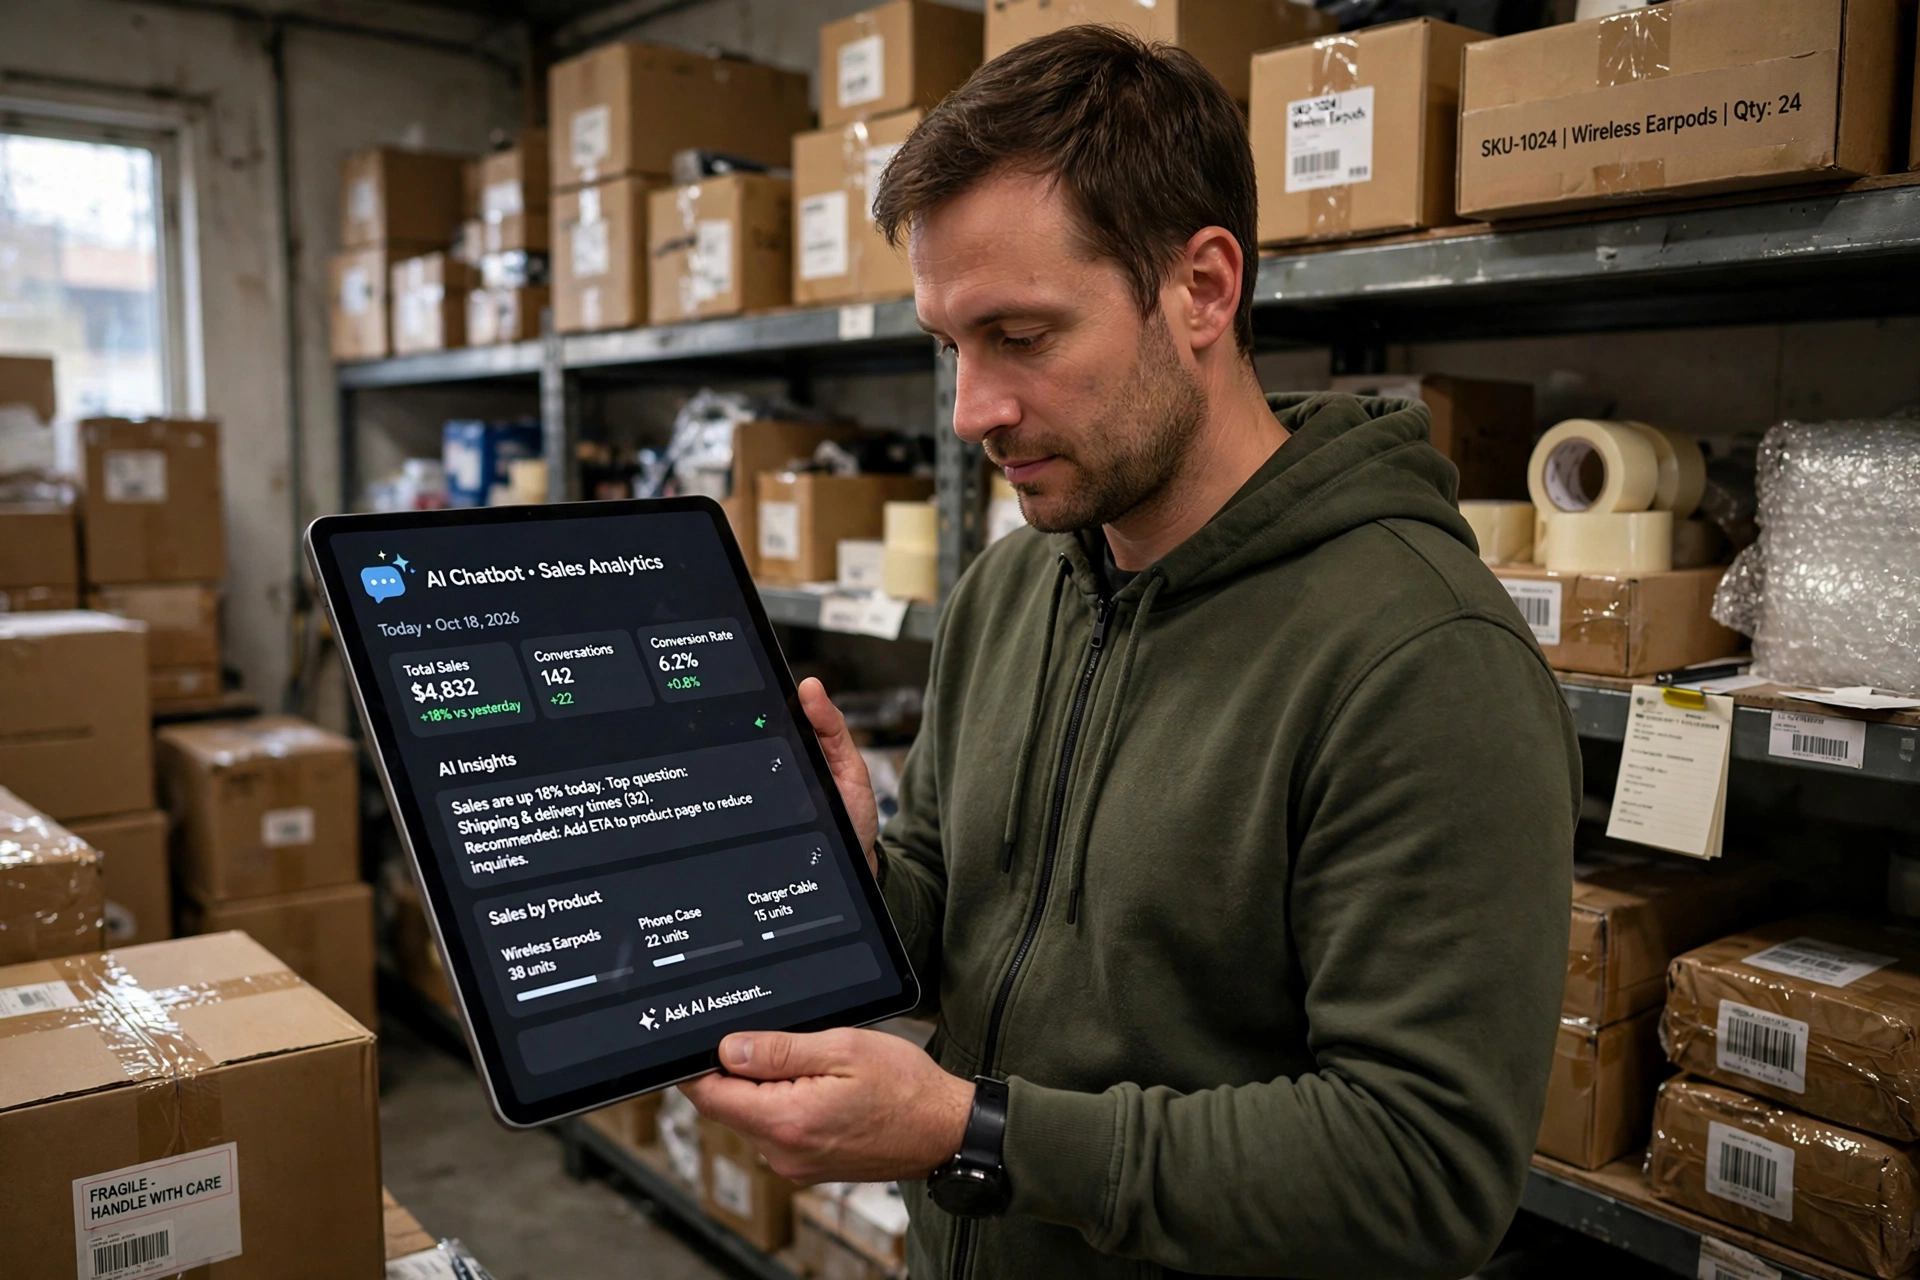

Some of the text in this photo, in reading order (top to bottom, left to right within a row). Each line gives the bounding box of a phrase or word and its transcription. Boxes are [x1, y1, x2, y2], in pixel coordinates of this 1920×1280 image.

[1481, 130, 1558, 158] SKU-1024
[1571, 120, 1641, 144] Wireless
[1645, 107, 1718, 136] Earpods
[1733, 98, 1772, 125] Qty:
[1778, 92, 1802, 114] 24
[427, 570, 447, 588] AI
[449, 565, 526, 586] Chatbot
[537, 558, 586, 579] Sales
[589, 554, 664, 575] Analytics
[377, 622, 422, 637] Today
[435, 617, 462, 632] Oct
[463, 615, 484, 630] 18,
[487, 611, 520, 627] 2026
[650, 630, 734, 649] Conversion Rate
[533, 643, 614, 663] Conversations
[658, 652, 699, 672] 6.2%
[403, 660, 470, 677] Total Sales
[541, 667, 575, 686] 142
[410, 677, 479, 704] $4,832
[666, 675, 701, 690] +0.8%
[420, 699, 522, 723] +18% vs yesterday
[550, 692, 575, 705] +22
[438, 752, 517, 777] AI Insights
[452, 767, 688, 816] Sales are up 18% today. Top question:
[458, 790, 654, 836] Shipping & delivery times (32).
[464, 793, 754, 855] Recommended: Add ETA to product page to reduce
[470, 854, 529, 875] inquiries.
[747, 879, 819, 908] Charger Cable
[488, 890, 604, 927] Sales by Product
[638, 907, 702, 931] Phone Case
[753, 903, 794, 923] 15 units
[501, 929, 602, 962] Wireless Earpods
[644, 929, 690, 948] 22 units
[507, 959, 558, 982] 38 units
[664, 983, 773, 1024] Ask AI Assistant...
[90, 1178, 148, 1203] FRAGILE
[91, 1175, 222, 1221] HANDLE WITH CARE
